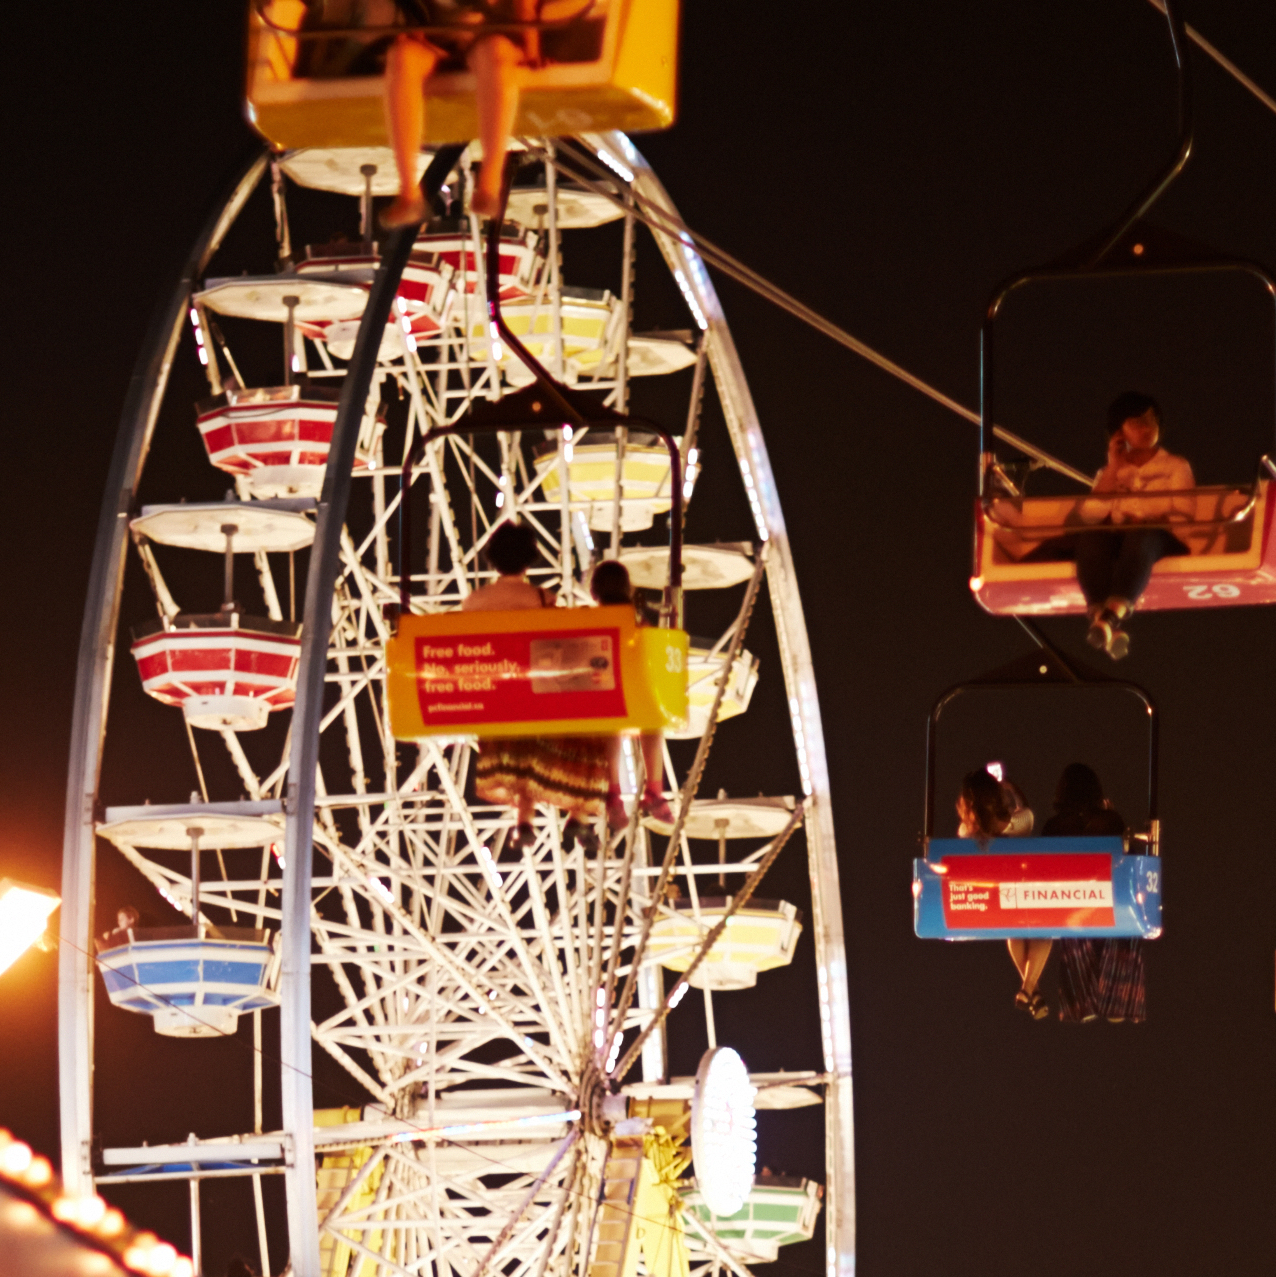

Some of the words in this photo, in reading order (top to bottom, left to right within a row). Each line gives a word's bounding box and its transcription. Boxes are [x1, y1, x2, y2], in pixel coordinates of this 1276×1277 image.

[1183, 583, 1241, 600] 62
[423, 645, 454, 659] Free
[458, 642, 495, 657] food.
[665, 644, 683, 674] 33
[425, 679, 454, 693] free
[458, 677, 496, 691] food.
[1146, 871, 1158, 893] 32
[950, 892, 966, 902] just
[967, 891, 990, 902] good
[1023, 890, 1106, 901] FINANCIAL
[950, 901, 988, 912] banking.
